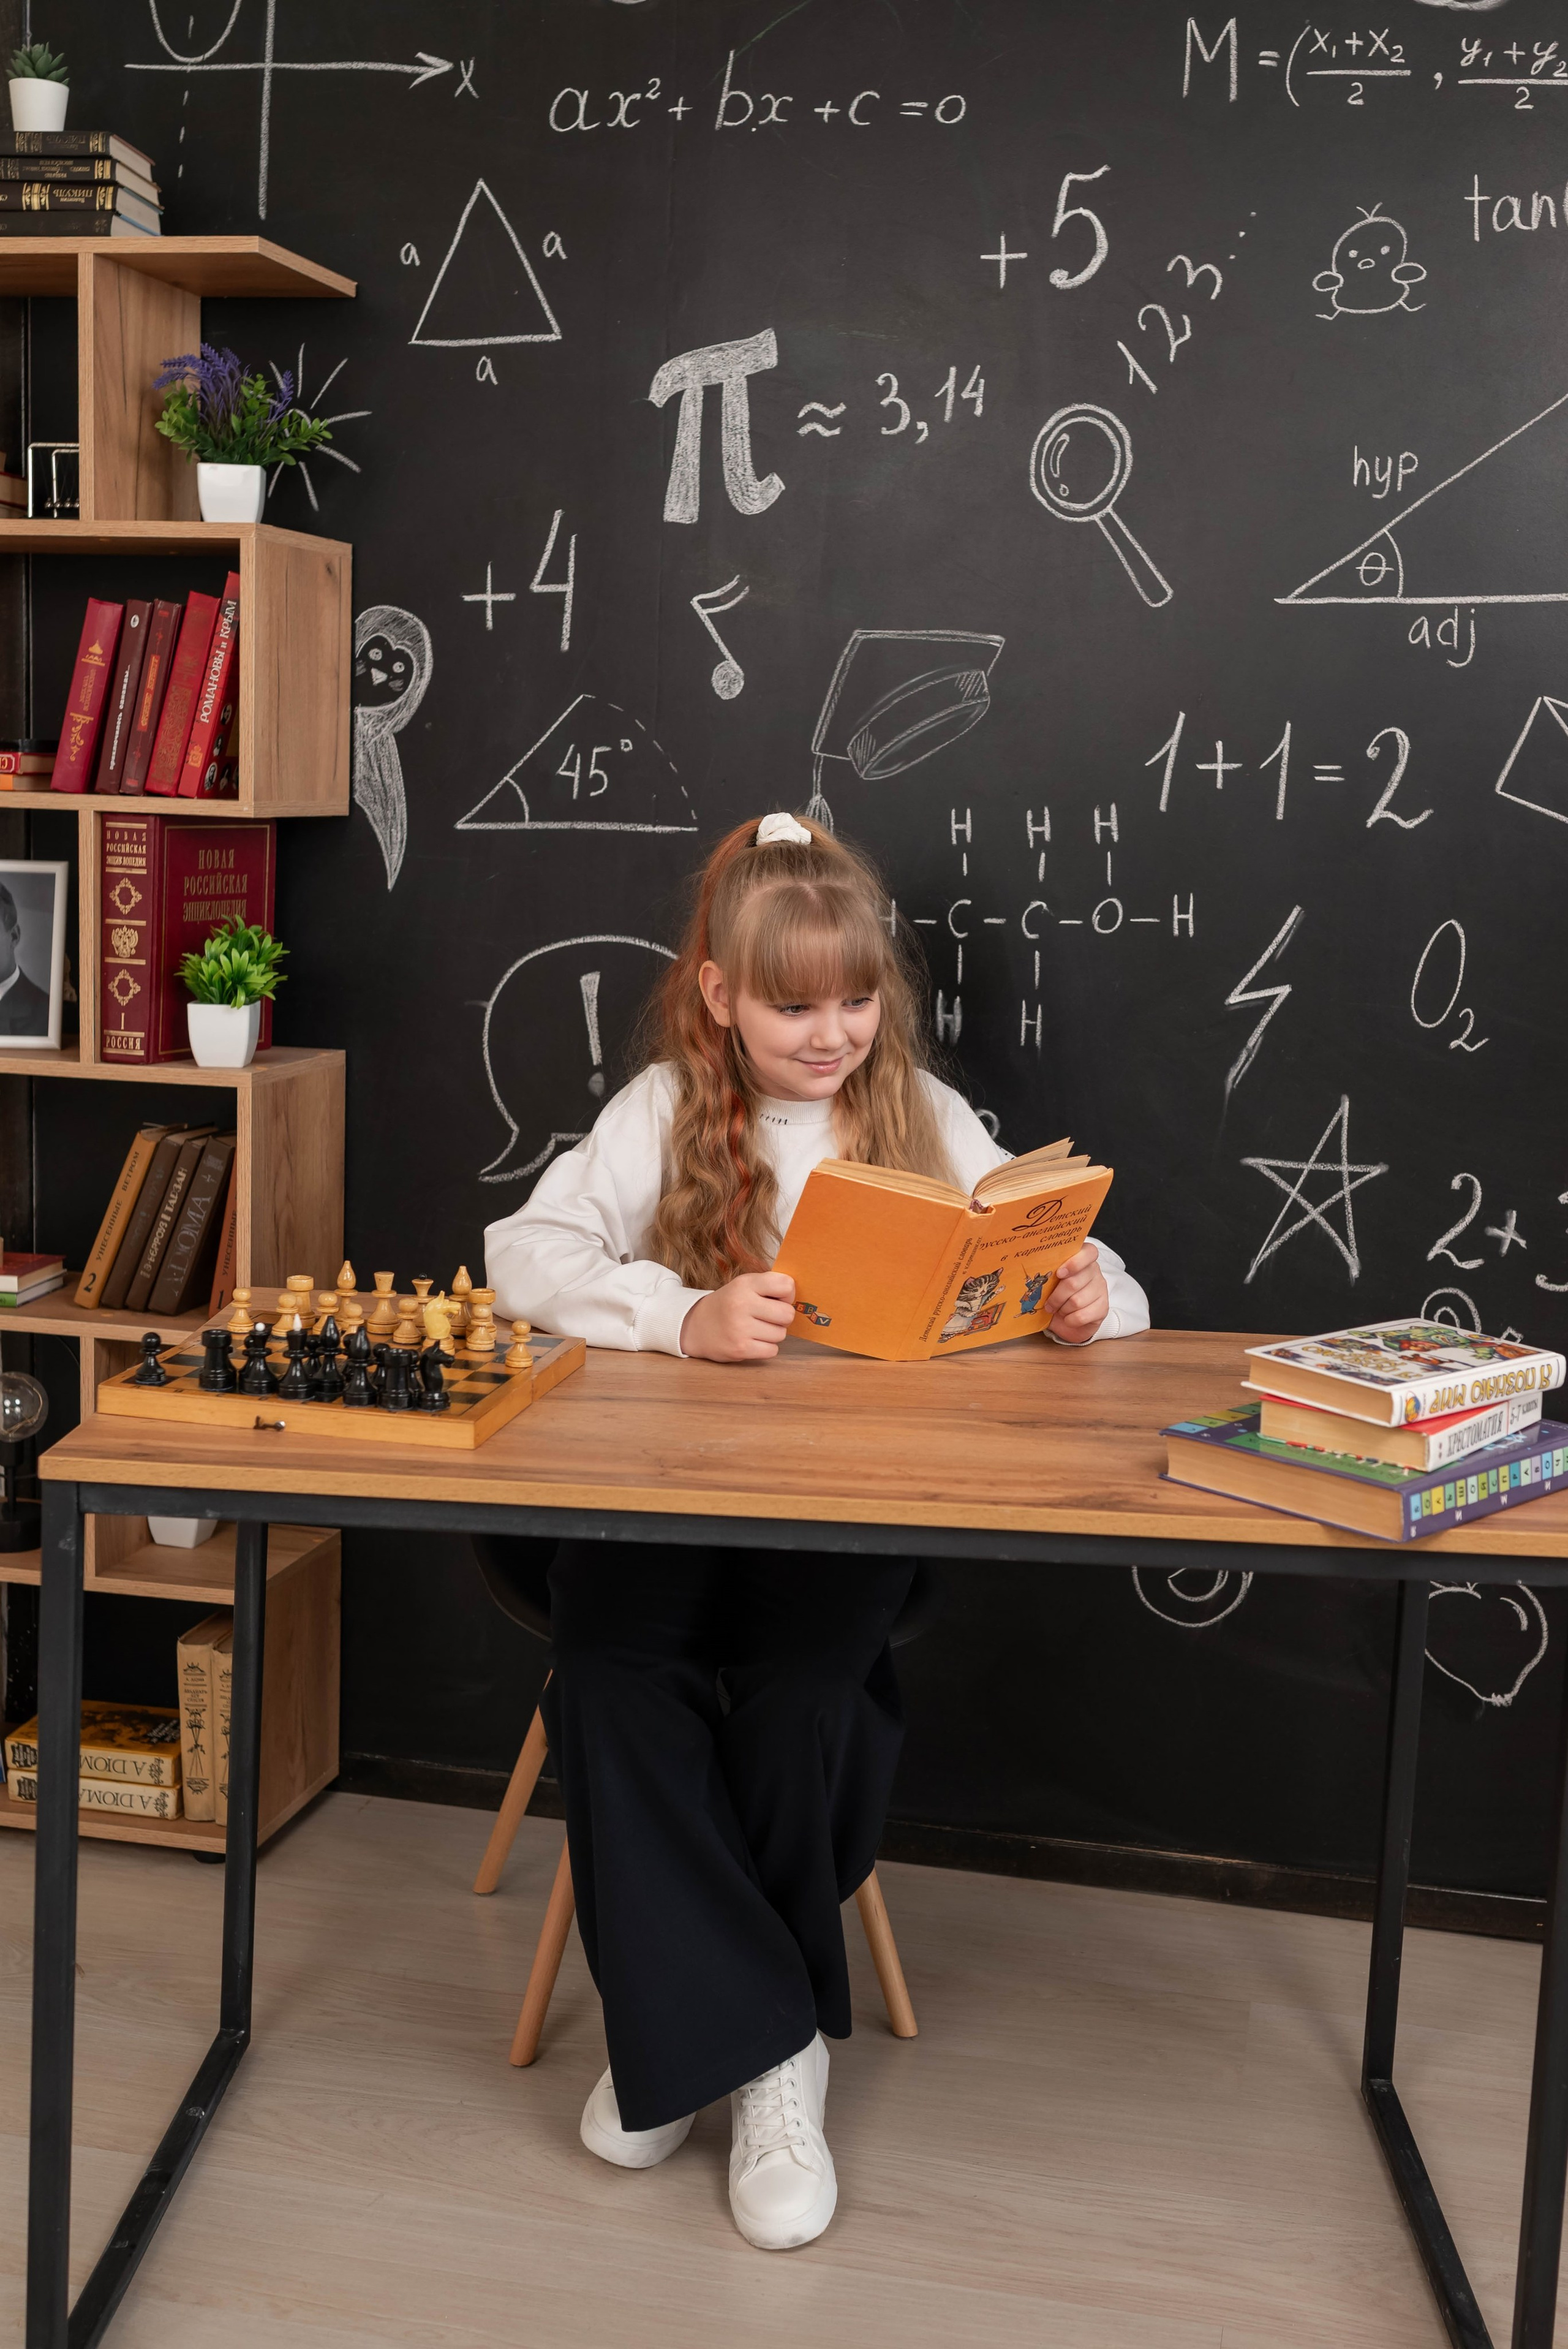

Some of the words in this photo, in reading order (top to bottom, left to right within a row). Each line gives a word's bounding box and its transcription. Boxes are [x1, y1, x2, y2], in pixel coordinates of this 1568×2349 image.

[53, 189, 93, 198] ПИКУЛЬ
[400, 243, 420, 266] a
[542, 232, 567, 259] a
[477, 356, 498, 385] a
[1354, 445, 1419, 498] hyp
[1408, 605, 1476, 667] adj
[200, 649, 225, 723] РОМАНОВЫ
[220, 600, 237, 639] КРЫМ
[106, 830, 146, 841] НОВАЯ
[106, 842, 146, 854] РОССИЙСКАЯ
[106, 855, 146, 867] ЭНЦИКЛОПЕДИЯ
[198, 849, 235, 869] НОВАЯ
[184, 872, 247, 896] РОССИЙСКАЯ
[106, 1035, 140, 1050] РОССИЯ
[96, 1199, 123, 1262] УНЕСЕННЫЕ
[121, 1151, 139, 1192] ВЕТРОМ
[1011, 1195, 1092, 1231] Детский
[979, 1215, 1087, 1250] русско-английский
[1040, 1226, 1082, 1243] словарь
[1014, 1235, 1079, 1258] картинках
[83, 1273, 96, 1293] 2
[919, 1315, 936, 1342] Детский
[933, 1260, 961, 1316] русско-английский
[959, 1237, 973, 1261] словарь
[1470, 1367, 1536, 1404] ПОЗНАЮ
[1539, 1364, 1553, 1390] Я
[1430, 1383, 1467, 1413] МИР
[1510, 1401, 1521, 1424] 5-7
[1447, 1411, 1504, 1457] ХРЕСТОМАТИЯ
